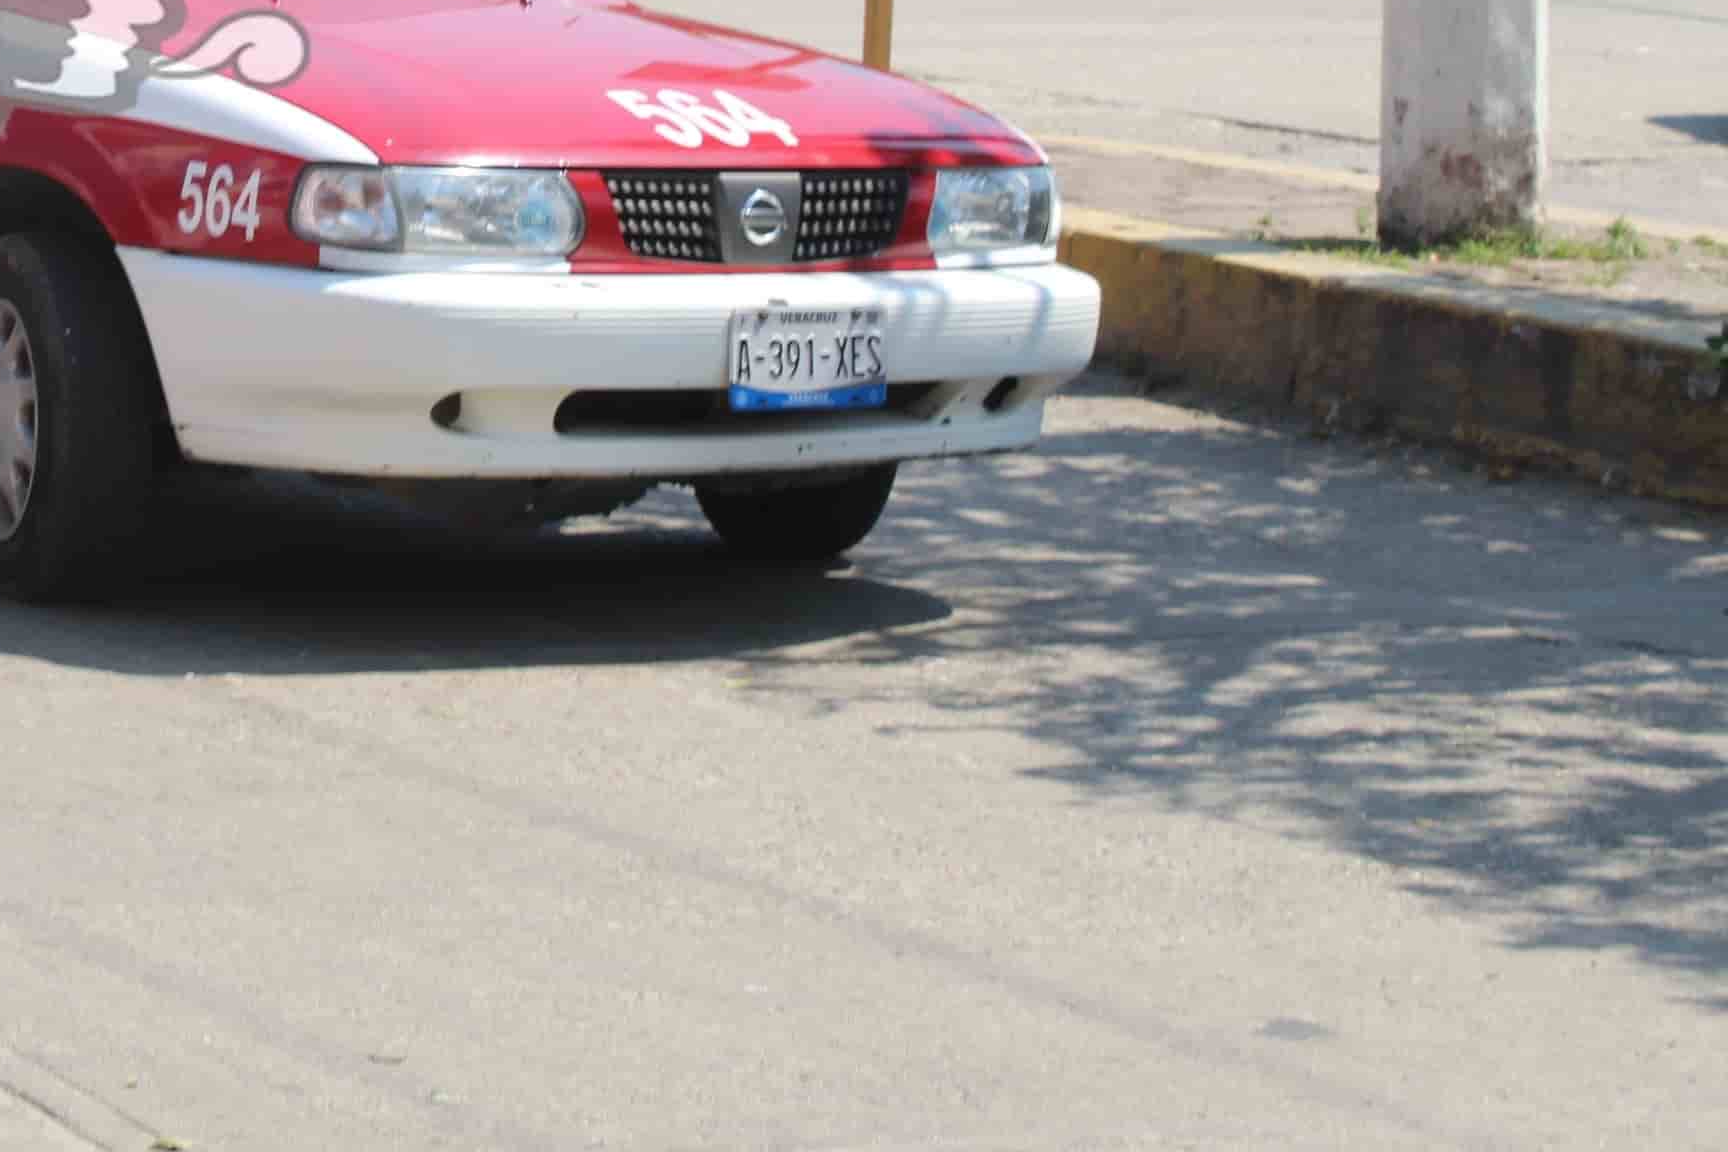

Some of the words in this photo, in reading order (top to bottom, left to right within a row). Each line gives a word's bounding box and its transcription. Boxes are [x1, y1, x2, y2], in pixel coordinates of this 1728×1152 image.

[605, 87, 800, 148] 564
[177, 158, 262, 242] 564
[737, 335, 882, 383] A-391-XES
